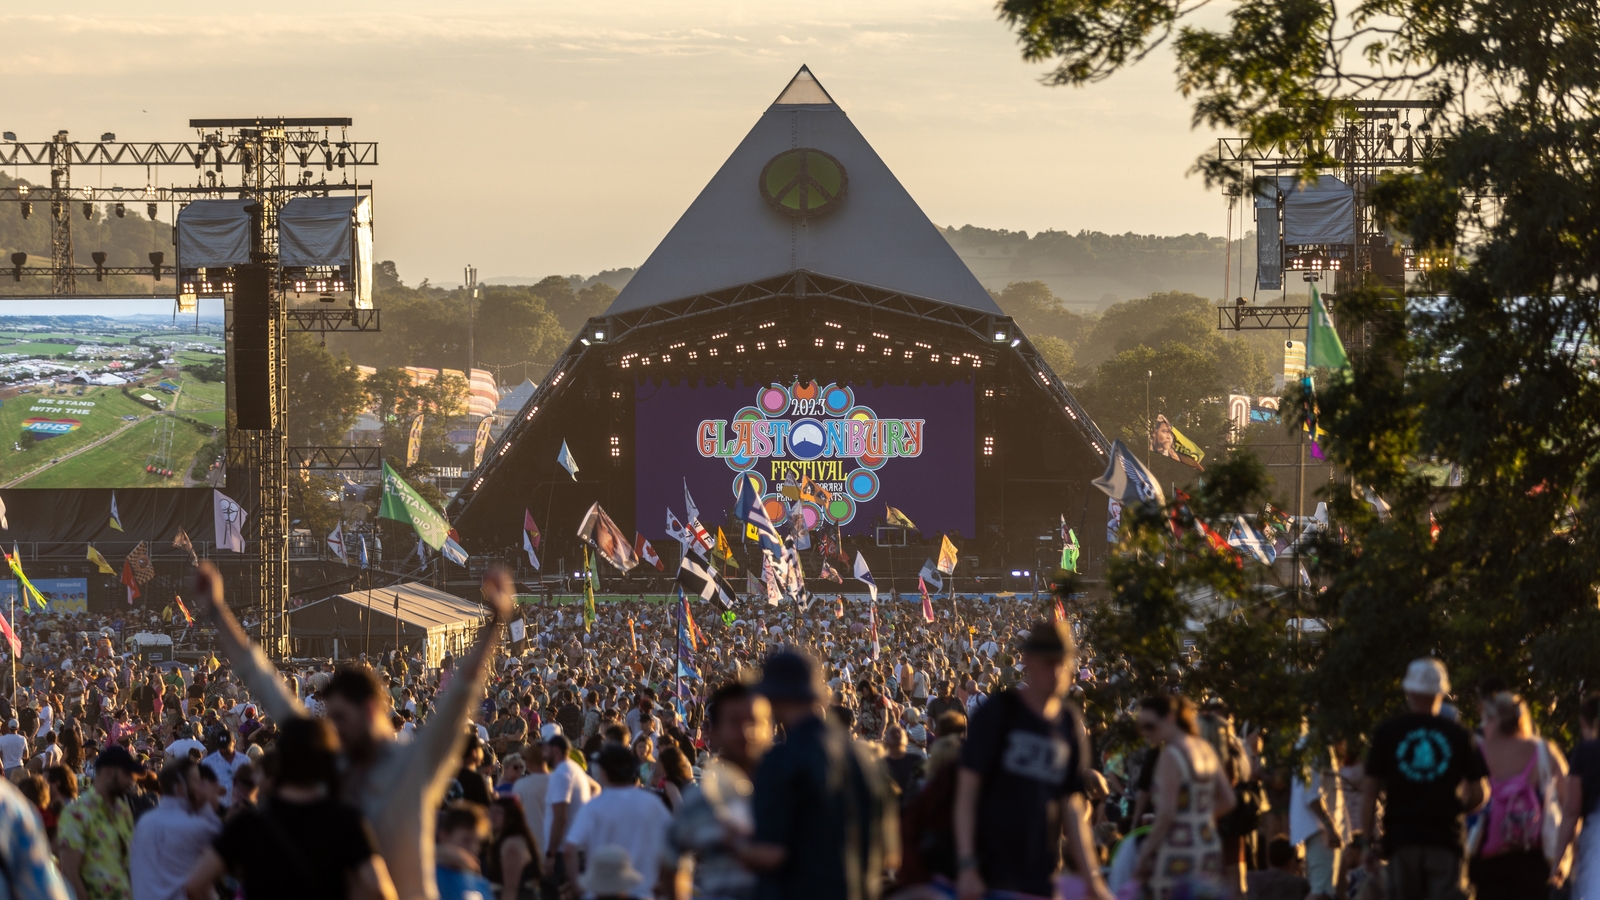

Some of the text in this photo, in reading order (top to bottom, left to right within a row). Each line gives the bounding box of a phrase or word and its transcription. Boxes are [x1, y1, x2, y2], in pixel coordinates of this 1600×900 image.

[791, 398, 826, 416] 2023
[29, 422, 70, 431] NHS
[697, 418, 925, 459] GLASTONBURY
[771, 461, 848, 481] FESTIVAL
